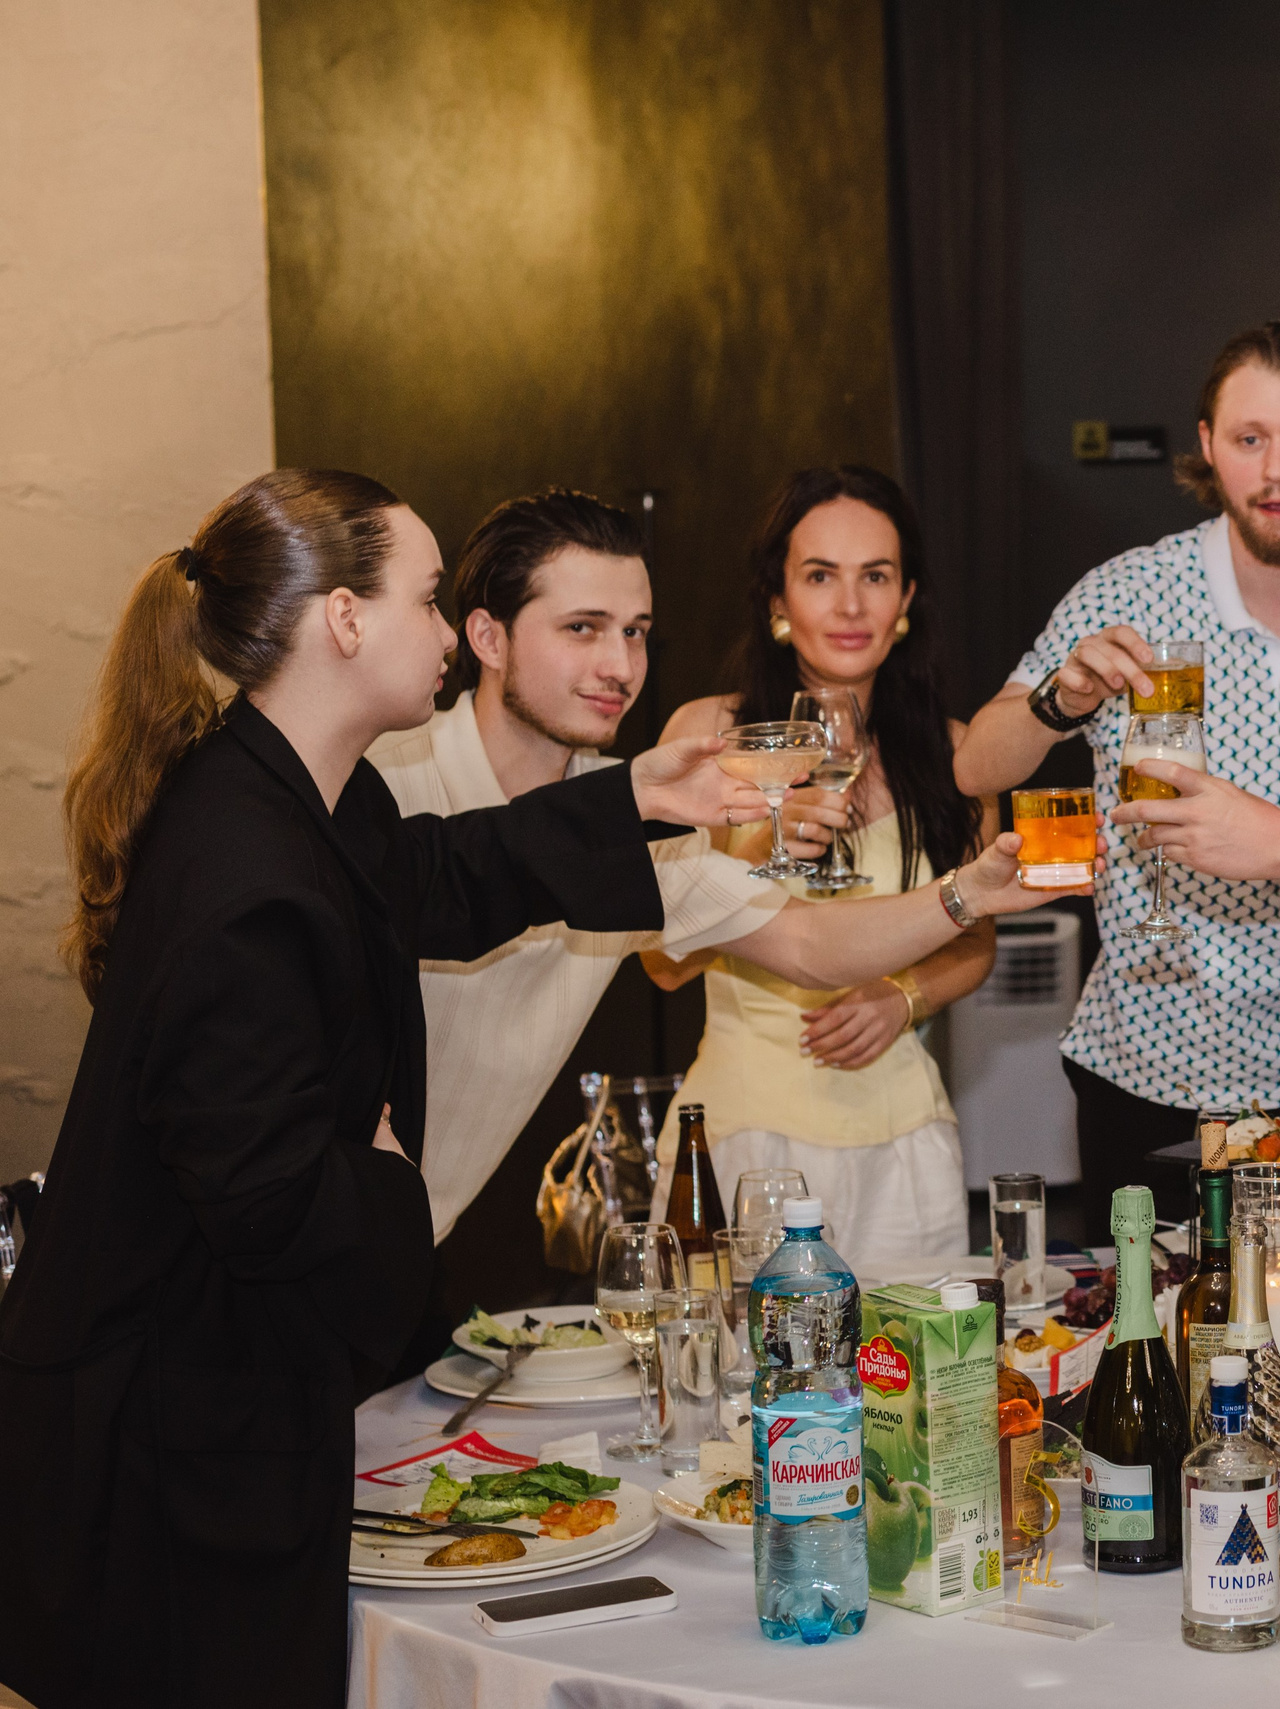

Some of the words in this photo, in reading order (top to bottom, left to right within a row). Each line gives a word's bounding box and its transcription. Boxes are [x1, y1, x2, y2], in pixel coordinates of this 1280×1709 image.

[1113, 1292, 1122, 1325] SANTO
[869, 1347, 897, 1366] Сады
[860, 1357, 907, 1380] Придонья
[864, 1407, 903, 1425] ЯБЛОКО
[872, 1422, 895, 1434] нектар
[772, 1455, 861, 1484] КАРАЧИНСКАЯ
[1017, 1449, 1063, 1537] 5
[961, 1508, 978, 1523] 1,93
[1224, 1566, 1262, 1574] VODKA
[1208, 1571, 1274, 1590] TUNDRA
[1224, 1595, 1264, 1605] AUTHENTIC
